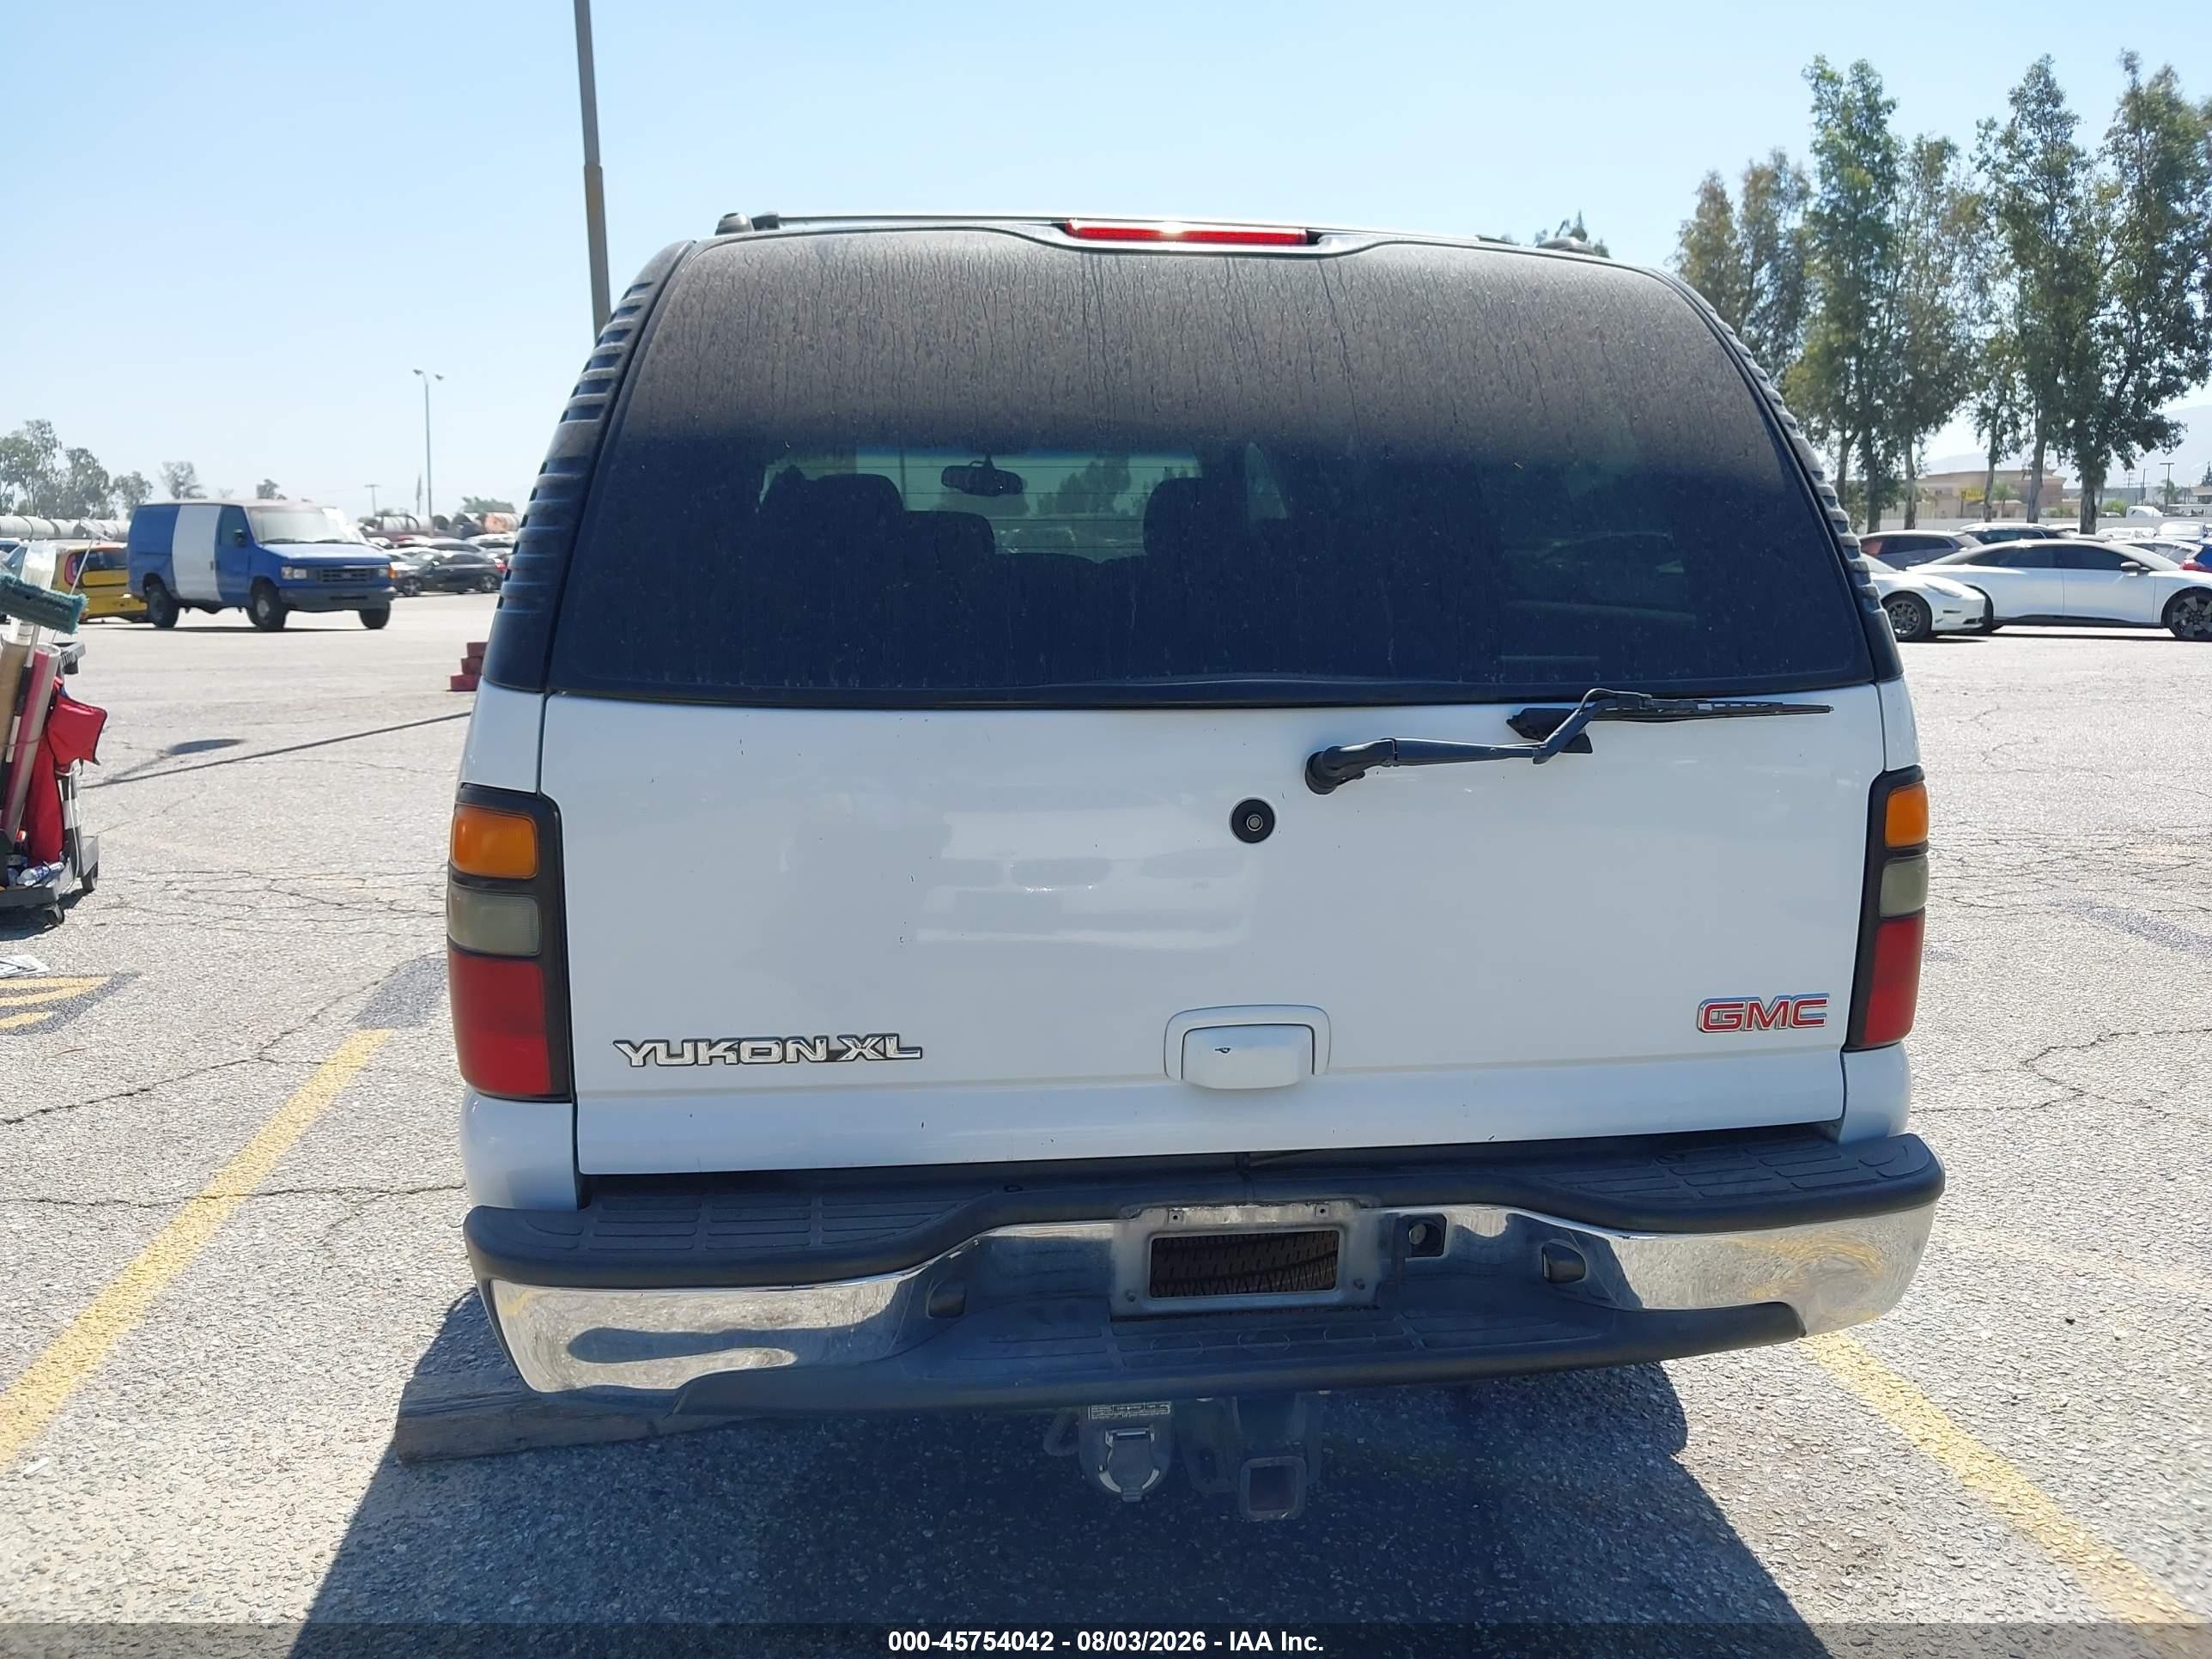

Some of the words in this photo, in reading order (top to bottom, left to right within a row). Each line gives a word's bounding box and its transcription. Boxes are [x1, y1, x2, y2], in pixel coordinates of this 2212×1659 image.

[1697, 993, 1829, 1033] GMC
[612, 1036, 829, 1067] YUKON
[836, 1033, 922, 1061] XL
